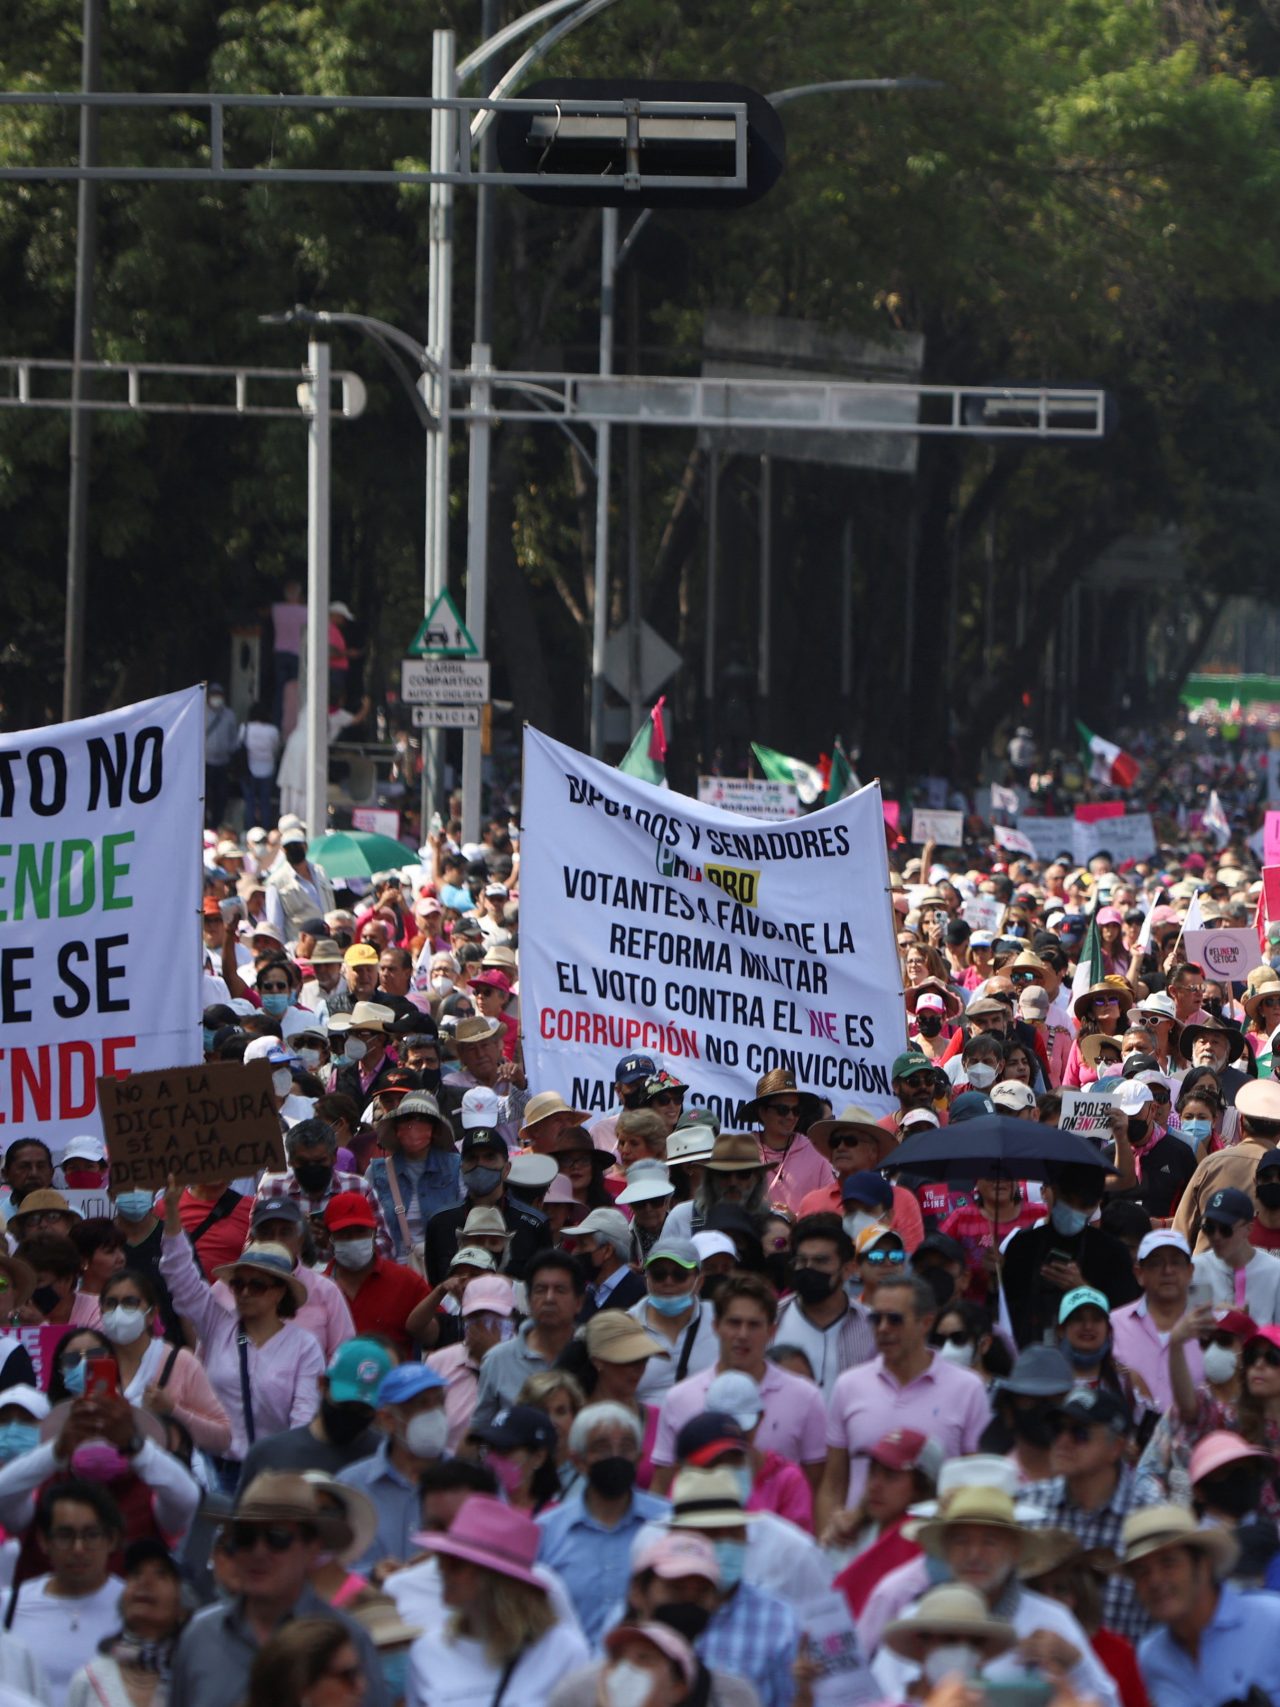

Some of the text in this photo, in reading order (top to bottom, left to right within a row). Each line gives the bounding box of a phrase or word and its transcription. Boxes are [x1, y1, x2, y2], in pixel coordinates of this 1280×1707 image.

[408, 675, 483, 687] COMPARTIDO
[425, 663, 465, 673] CARRIL
[429, 712, 476, 723] INICIA
[87, 726, 164, 811] NO
[686, 822, 701, 850] Y
[706, 825, 851, 861] SENADORES
[563, 865, 696, 921] VOTANTES
[717, 900, 784, 940] FAVO
[824, 922, 856, 955] LA
[53, 934, 130, 1019] SE
[609, 923, 828, 995] REFORMA MILITAR
[556, 961, 875, 1048] EL VOTO CONTRA EL NE ES
[540, 1007, 700, 1060] CORRUPCIÓN
[705, 1034, 739, 1067] NO
[0, 1036, 136, 1125] ND
[115, 1075, 211, 1105] NO A LA
[113, 1090, 279, 1136] DICTADURA
[112, 1141, 278, 1184] DEMOCRACIA
[166, 1135, 179, 1152] A
[195, 1127, 220, 1146] LA
